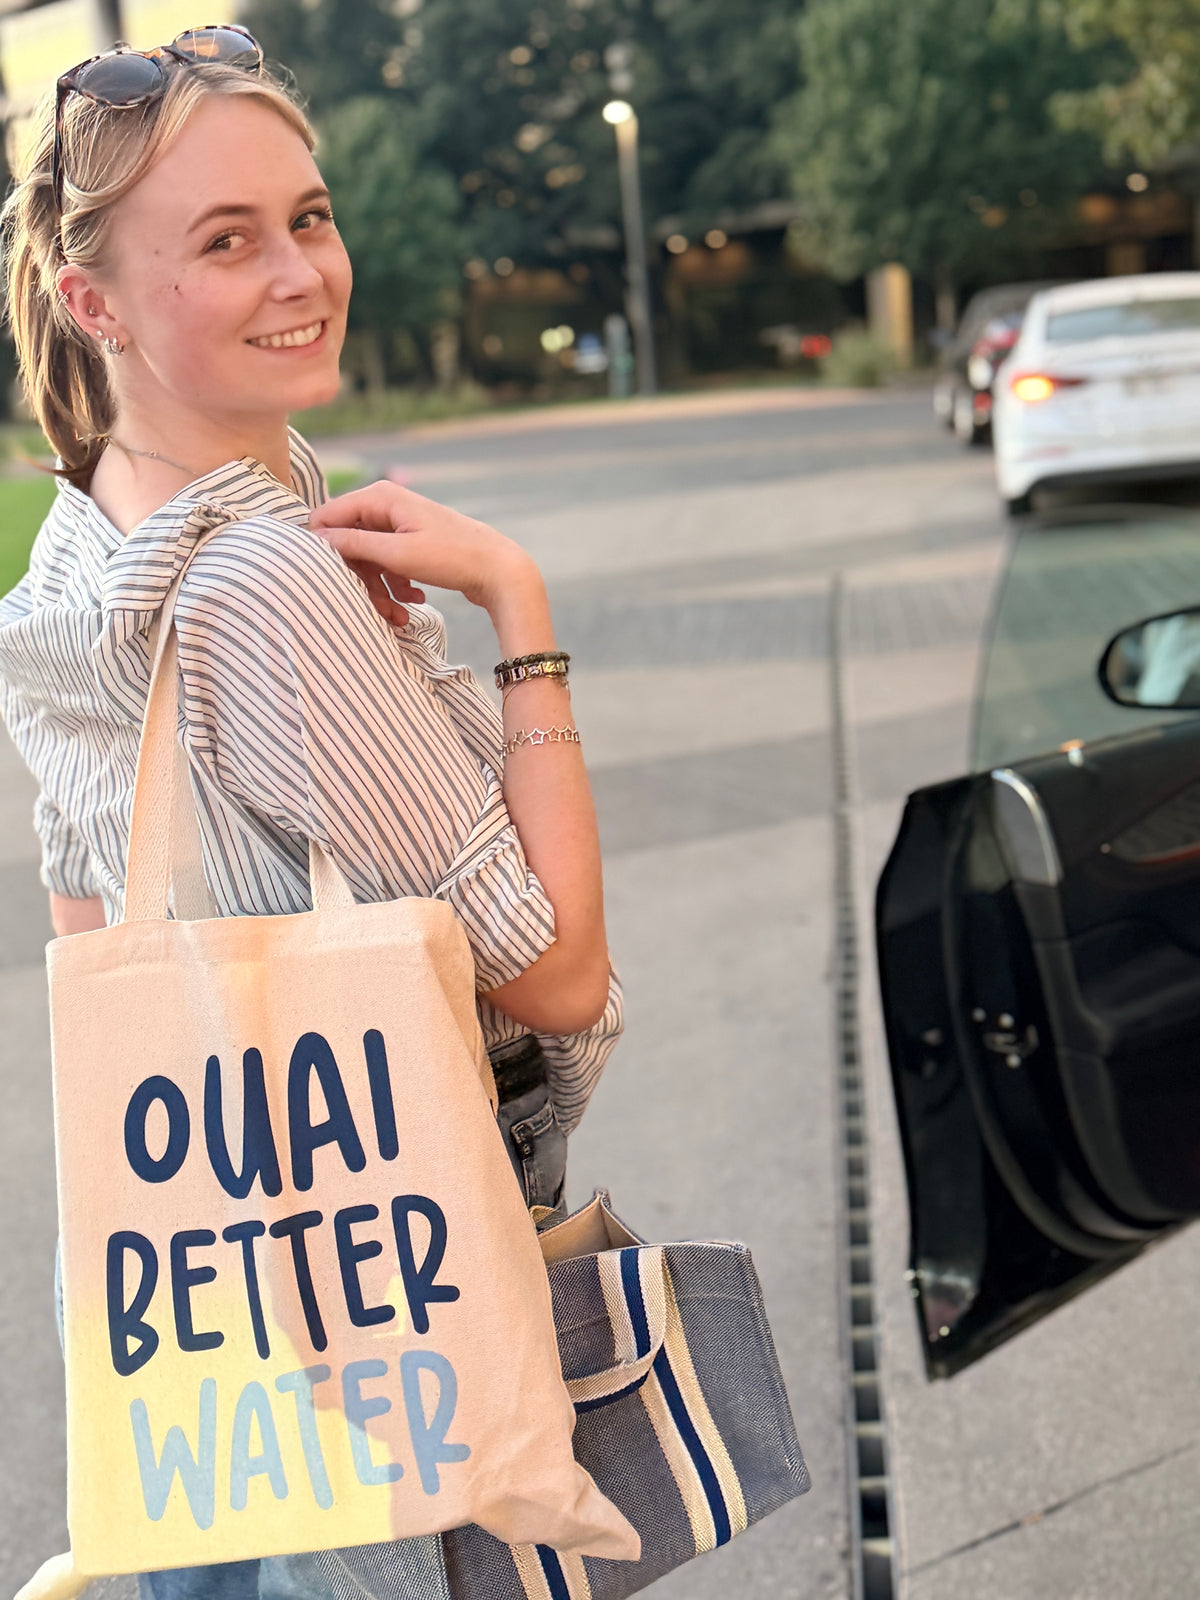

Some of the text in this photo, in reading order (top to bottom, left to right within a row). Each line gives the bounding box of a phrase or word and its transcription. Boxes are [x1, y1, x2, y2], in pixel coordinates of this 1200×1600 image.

[124, 1028, 400, 1200] OUAI
[106, 1194, 461, 1377] BETTER
[129, 1350, 472, 1531] WATER
